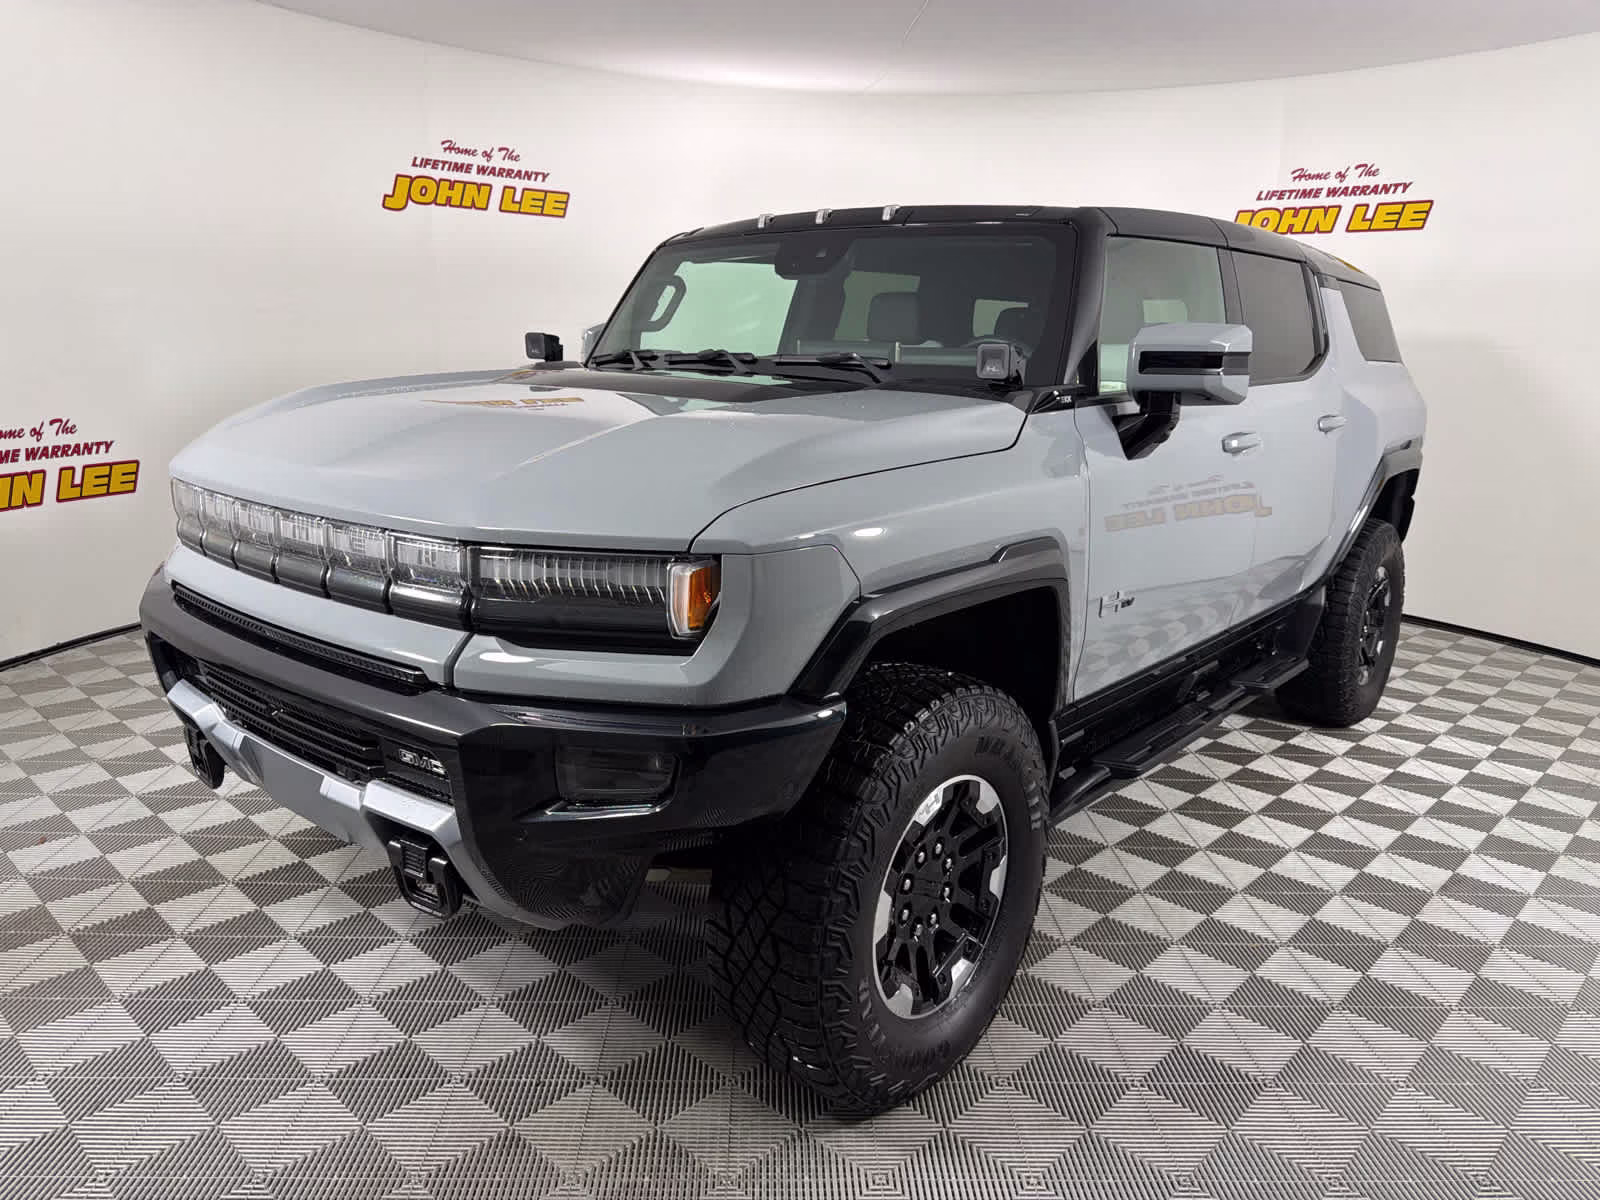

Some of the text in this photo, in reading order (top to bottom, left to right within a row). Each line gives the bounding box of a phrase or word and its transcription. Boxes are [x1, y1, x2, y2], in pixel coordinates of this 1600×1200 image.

[441, 139, 521, 162] Home of The
[411, 156, 550, 182] LIFETIME WARRANTY
[1291, 163, 1380, 182] Home of The
[382, 174, 570, 218] JOHN LEE
[1256, 181, 1413, 201] LIFETIME WARRANTY
[1345, 200, 1434, 233] LEE
[29, 420, 44, 442] of
[49, 418, 78, 437] The
[25, 440, 115, 461] WARRANTY
[56, 459, 140, 503] LEE
[399, 748, 446, 775] GMC
